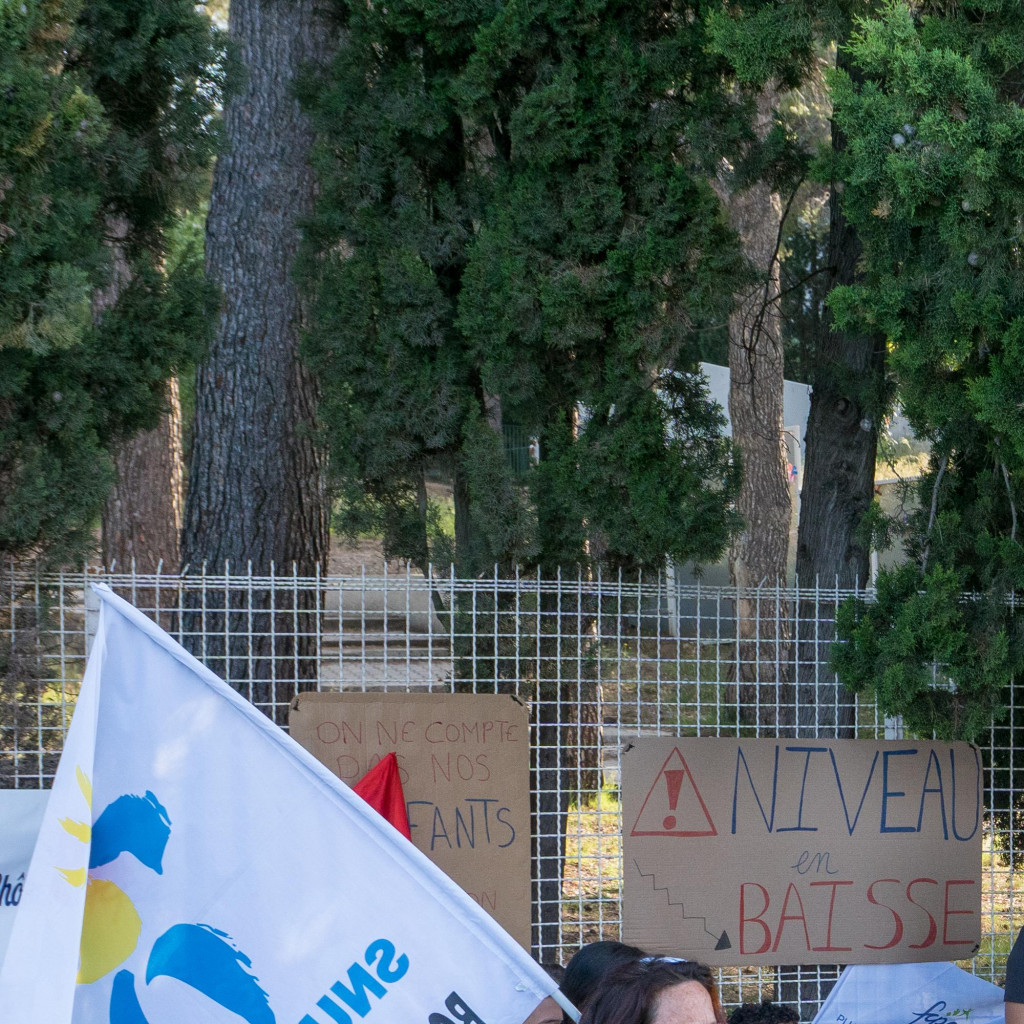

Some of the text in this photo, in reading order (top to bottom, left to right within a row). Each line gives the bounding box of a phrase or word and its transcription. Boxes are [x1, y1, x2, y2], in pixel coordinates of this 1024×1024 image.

[316, 720, 519, 745] ON NE COMPTE
[431, 753, 491, 783] NOS
[731, 745, 981, 842] NIVEAU
[406, 798, 516, 851] FANTS
[791, 849, 839, 875] en
[740, 877, 975, 955] BAISSE
